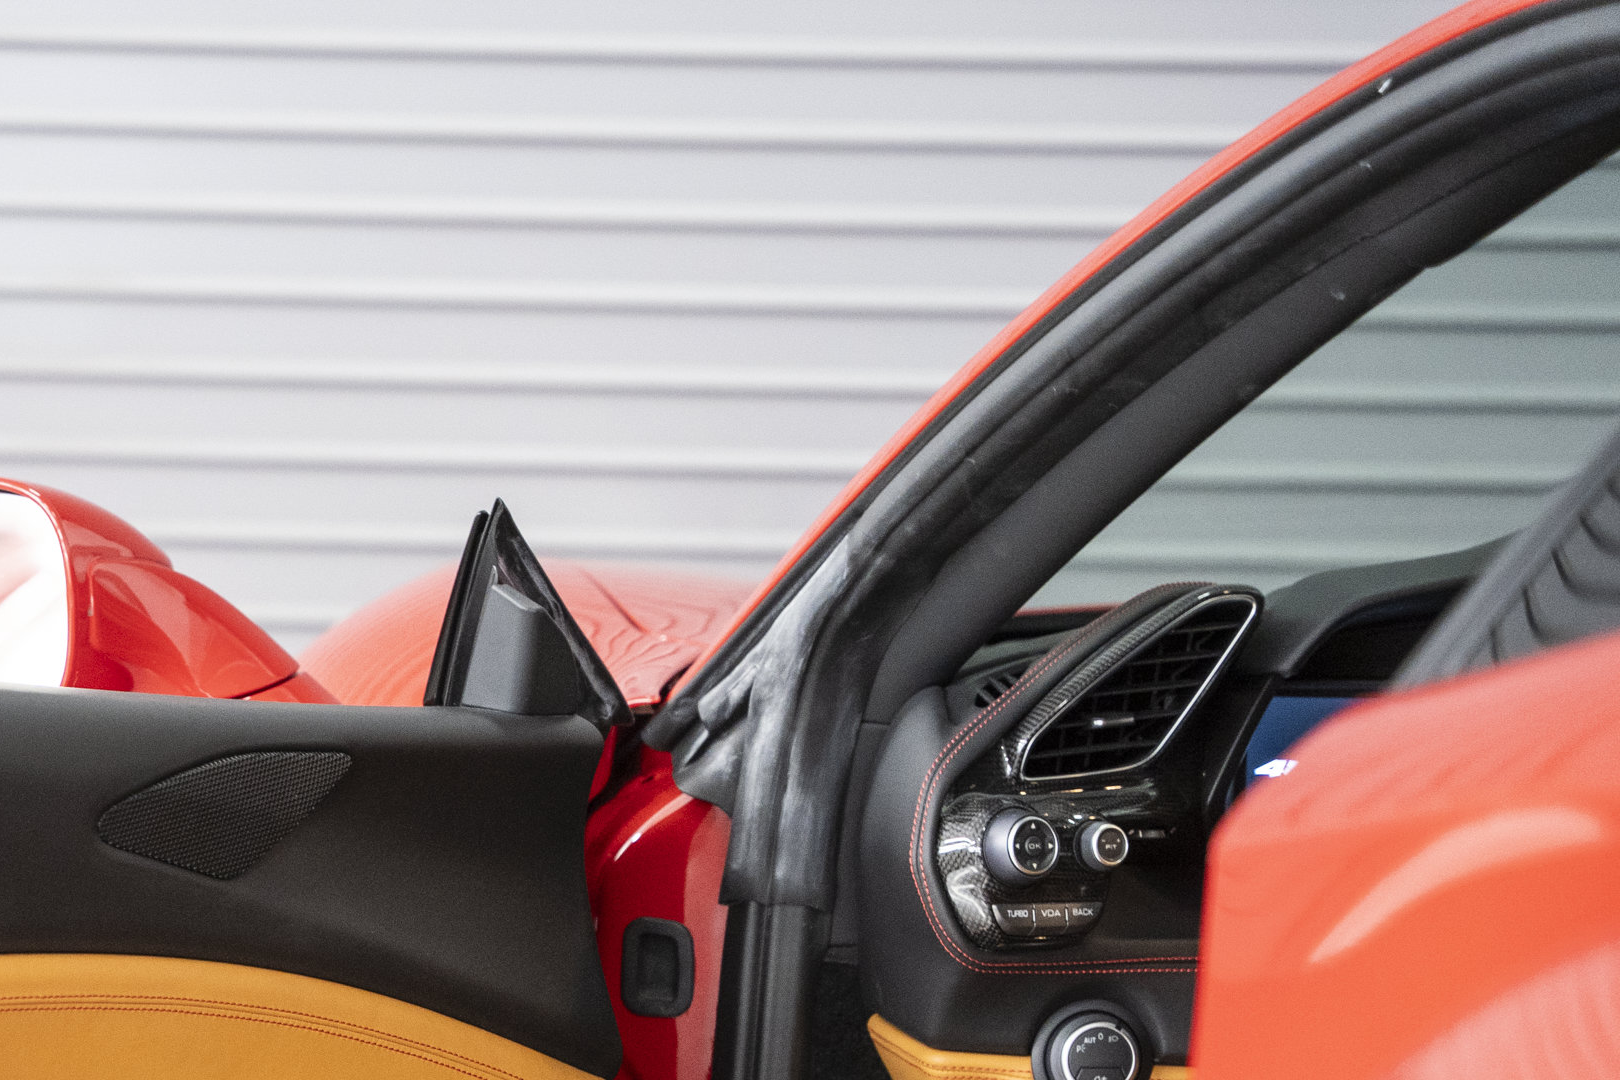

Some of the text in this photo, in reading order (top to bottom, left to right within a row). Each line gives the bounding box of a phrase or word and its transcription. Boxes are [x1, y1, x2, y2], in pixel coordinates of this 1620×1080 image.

[1028, 842, 1042, 850] OK
[1007, 909, 1029, 918] TURBO
[1072, 908, 1094, 917] BACK
